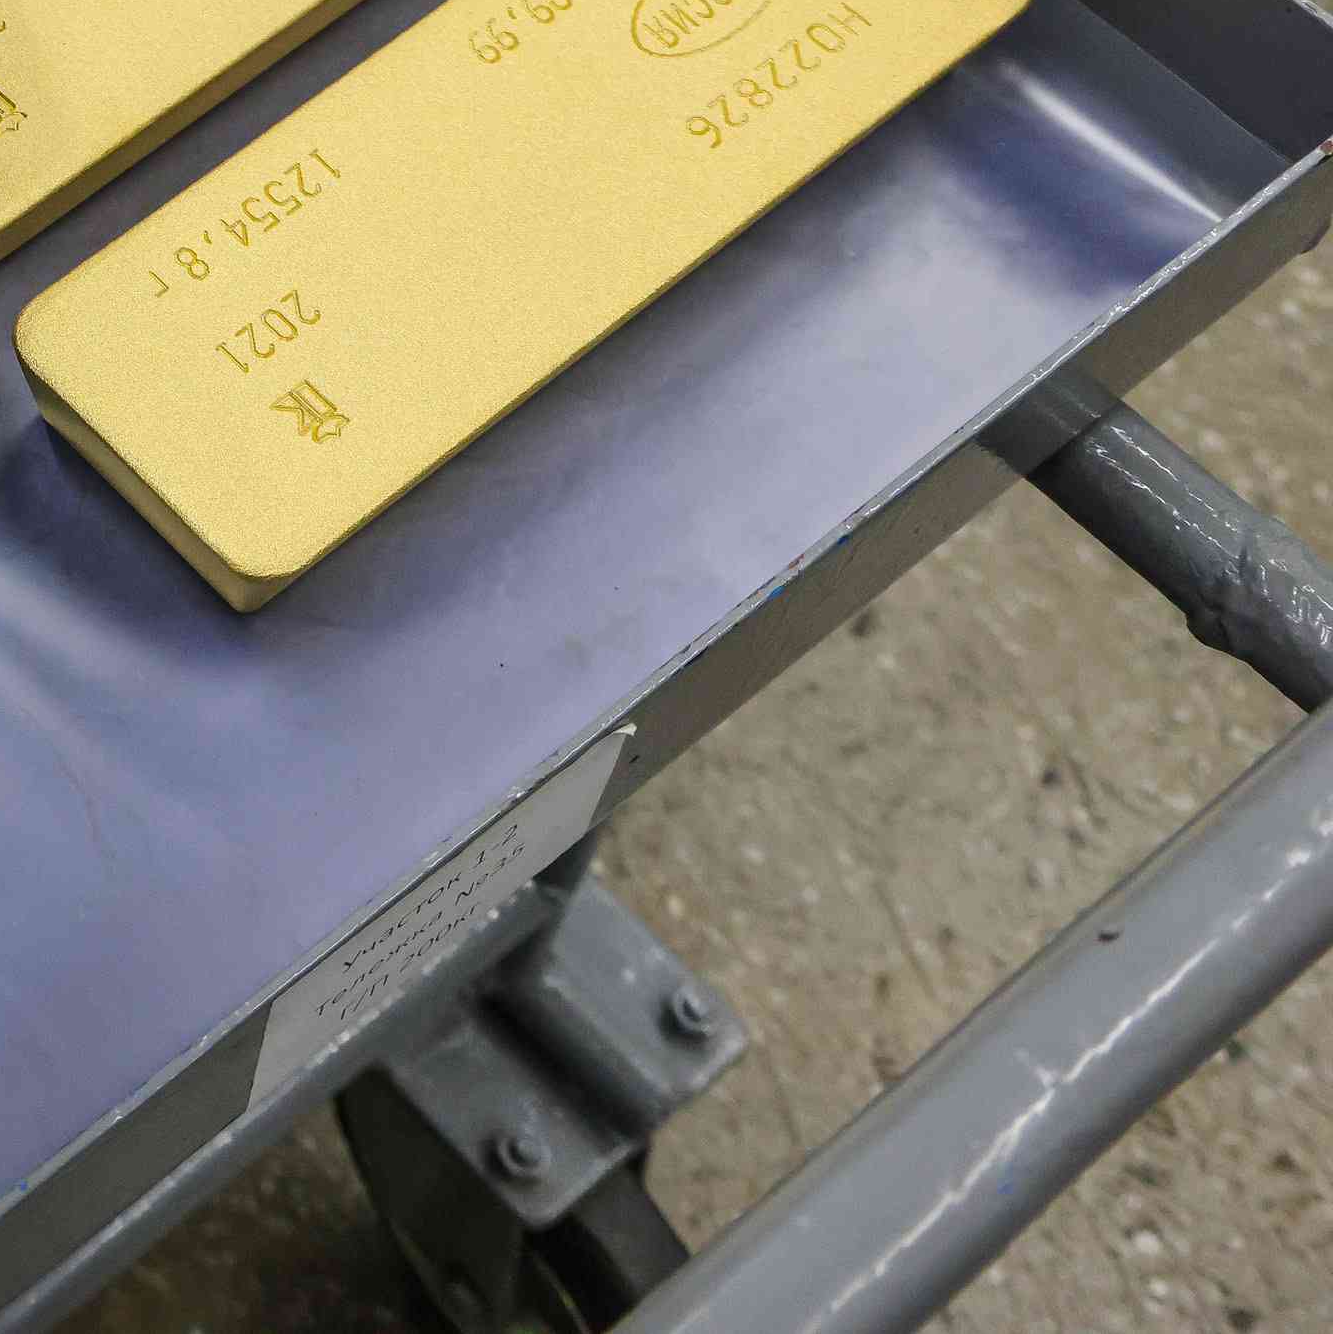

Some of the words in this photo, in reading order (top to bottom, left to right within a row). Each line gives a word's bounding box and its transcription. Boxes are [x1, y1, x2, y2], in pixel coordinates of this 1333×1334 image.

[170, 148, 342, 285] 12554,8
[213, 288, 322, 375] 2021
[343, 872, 462, 974] Участок
